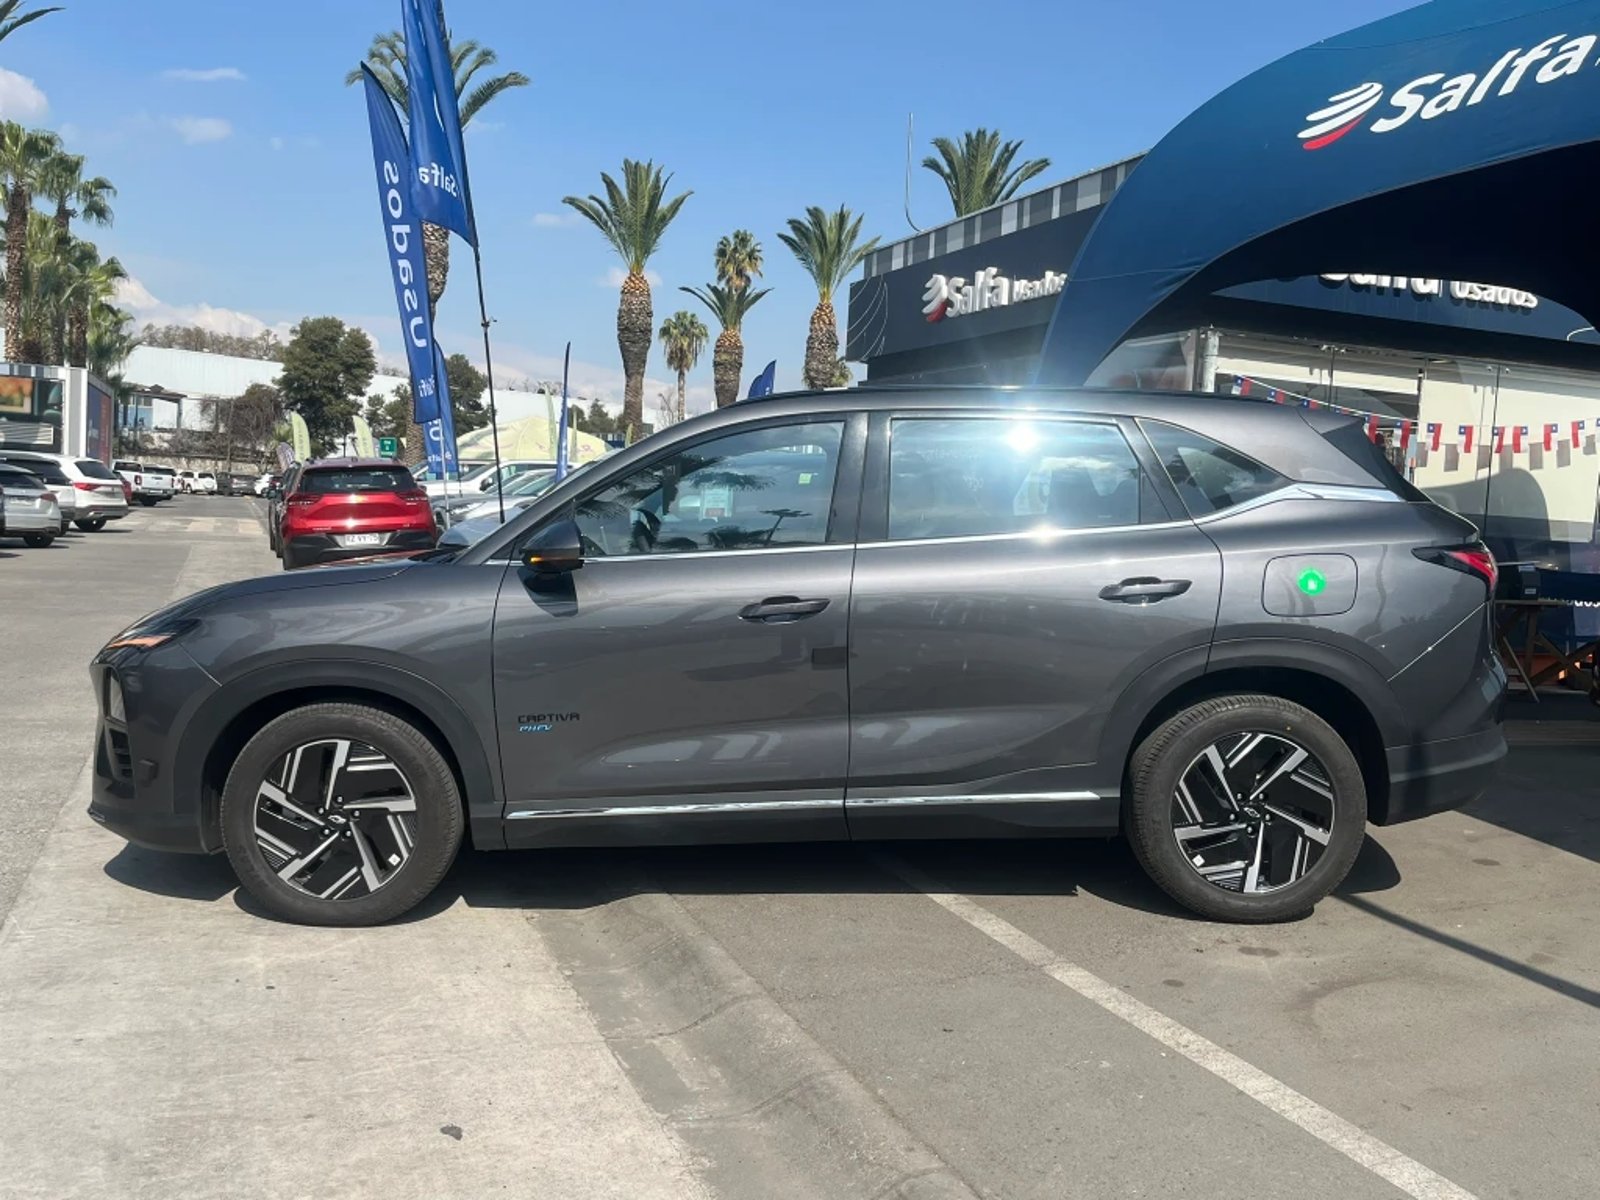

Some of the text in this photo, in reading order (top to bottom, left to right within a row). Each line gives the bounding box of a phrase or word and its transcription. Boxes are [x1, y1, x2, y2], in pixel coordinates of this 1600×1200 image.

[1369, 33, 1597, 133] Salfa
[945, 266, 1010, 319] Salfa
[517, 711, 581, 724] CAPTIVA
[519, 723, 553, 733] PHEV
